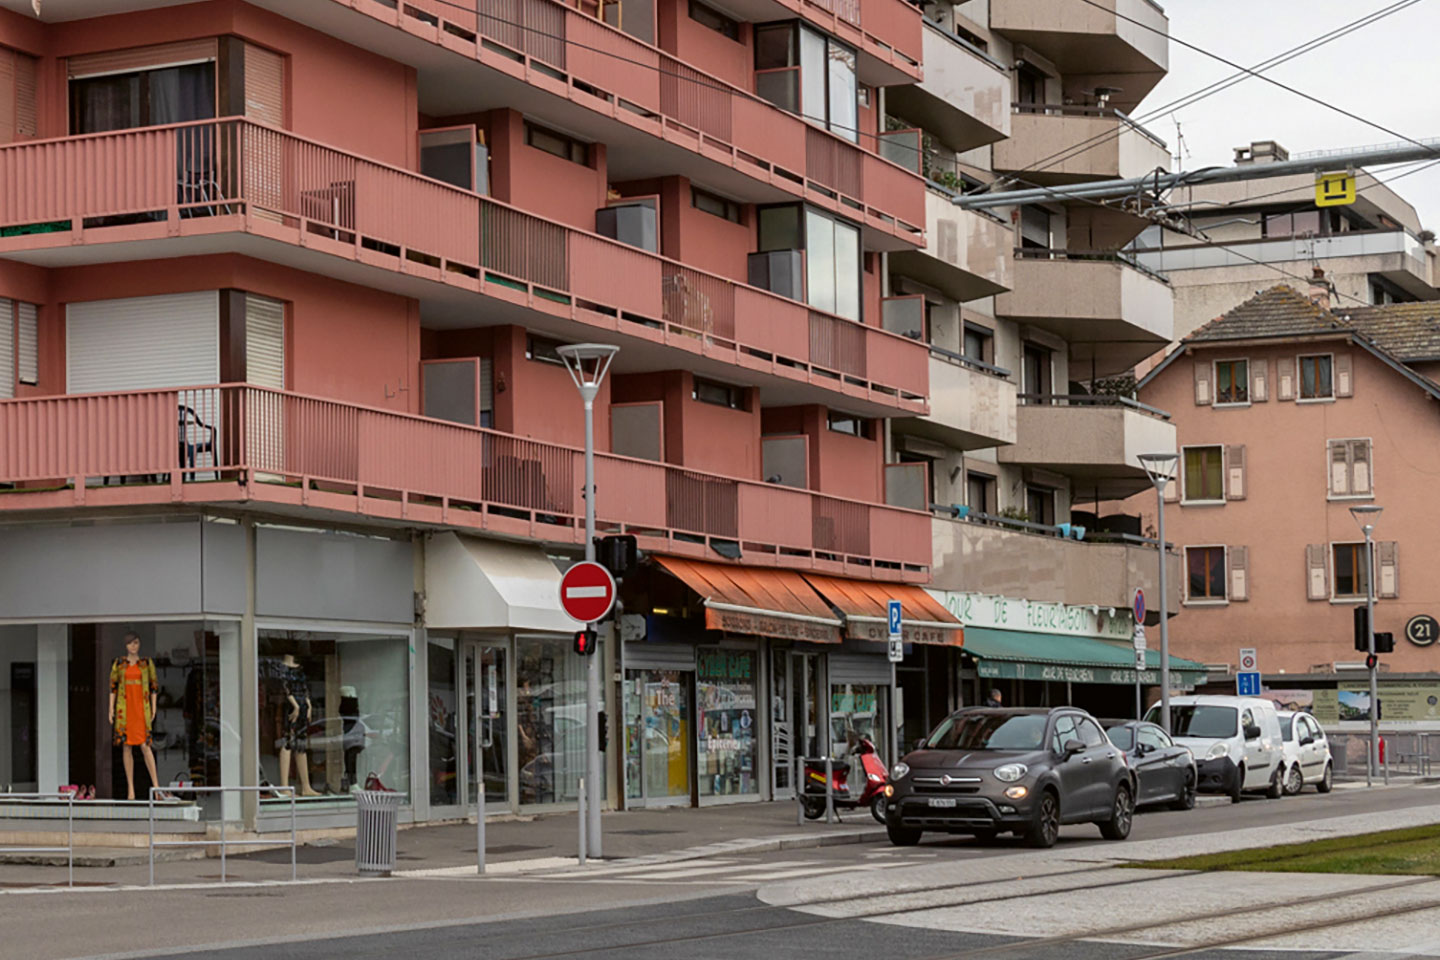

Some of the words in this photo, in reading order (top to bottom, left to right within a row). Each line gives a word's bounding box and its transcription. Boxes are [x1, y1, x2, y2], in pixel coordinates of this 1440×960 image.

[947, 596, 972, 620] OUR
[868, 627, 910, 639] CYR
[1414, 623, 1431, 638] 21
